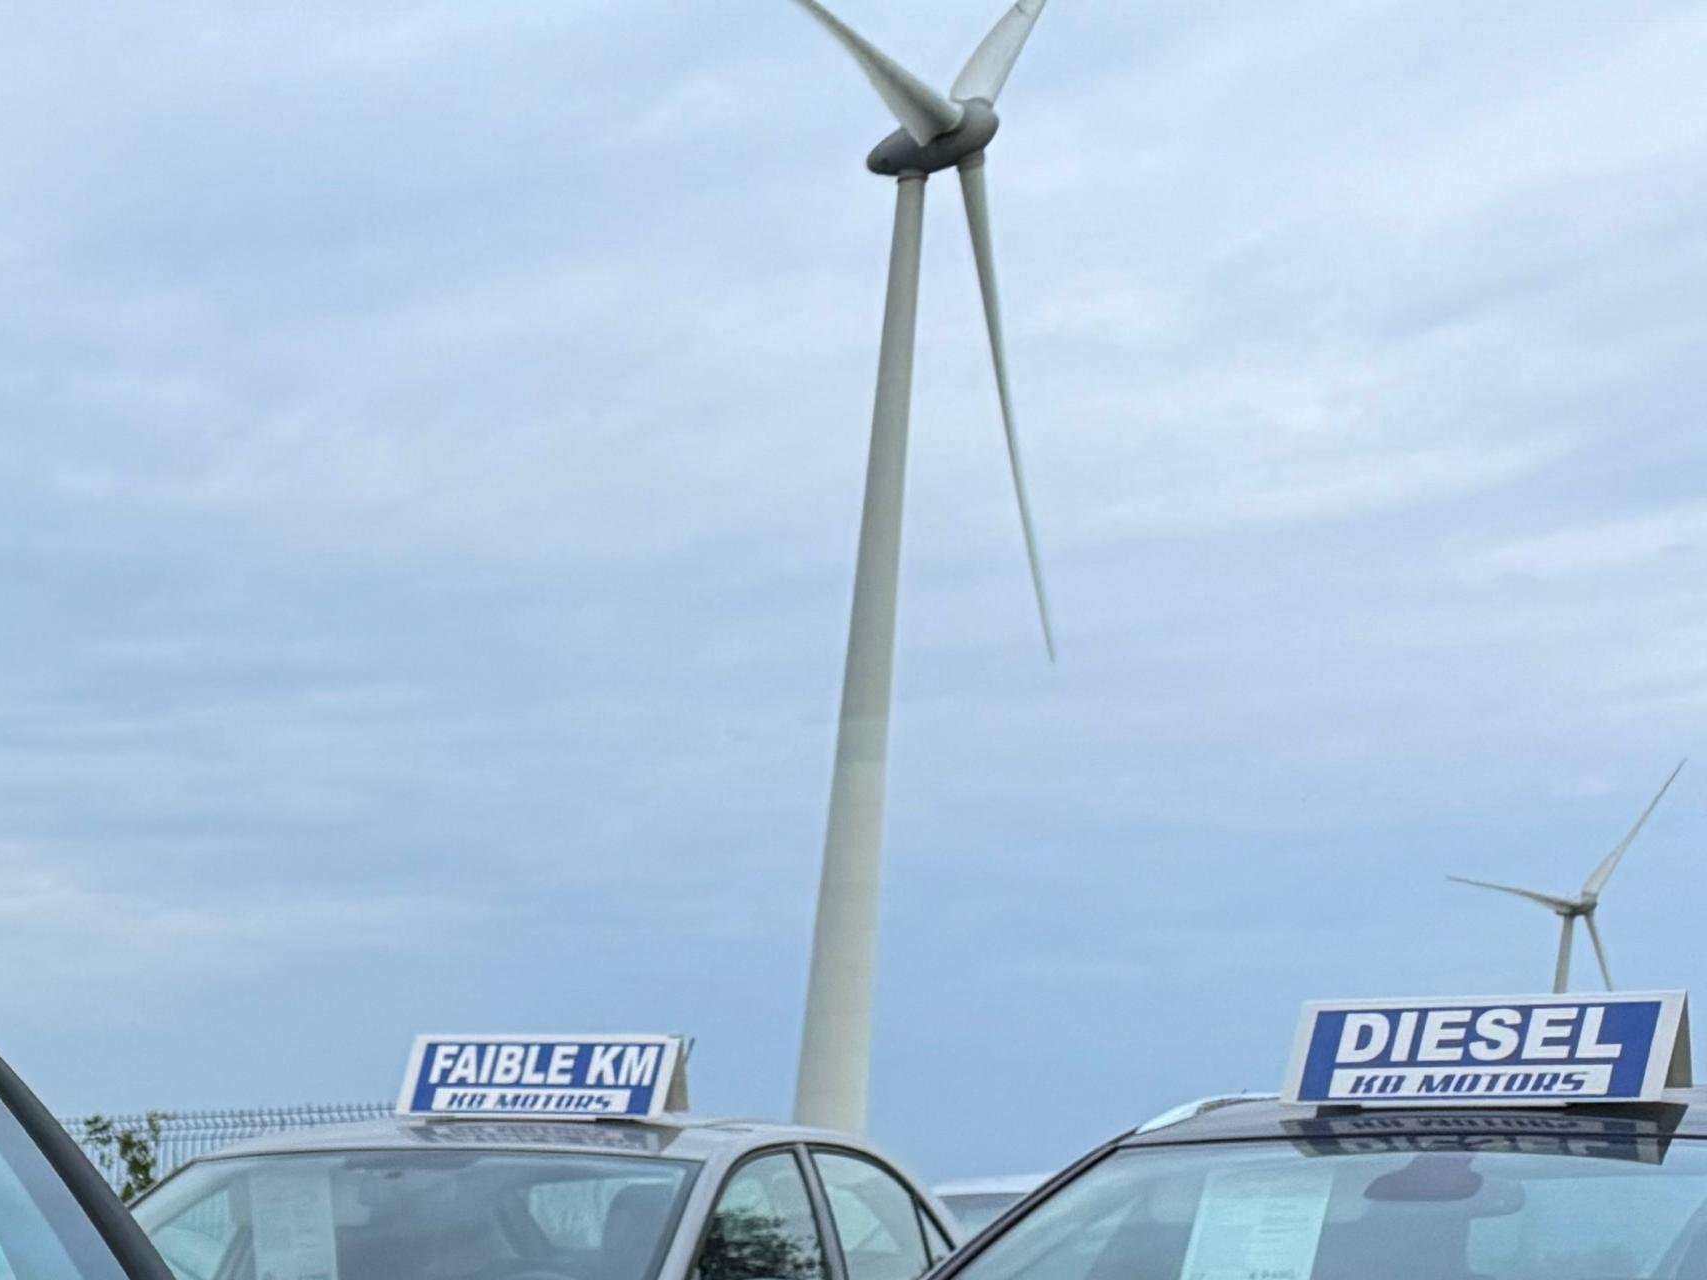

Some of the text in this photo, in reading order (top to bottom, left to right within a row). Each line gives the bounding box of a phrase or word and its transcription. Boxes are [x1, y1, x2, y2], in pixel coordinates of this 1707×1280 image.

[1335, 1006, 1622, 1064] DIESEL
[428, 1045, 660, 1087] FAIBLE KM
[1417, 1070, 1591, 1094] MOTORS
[491, 1091, 612, 1111] MOTORS
